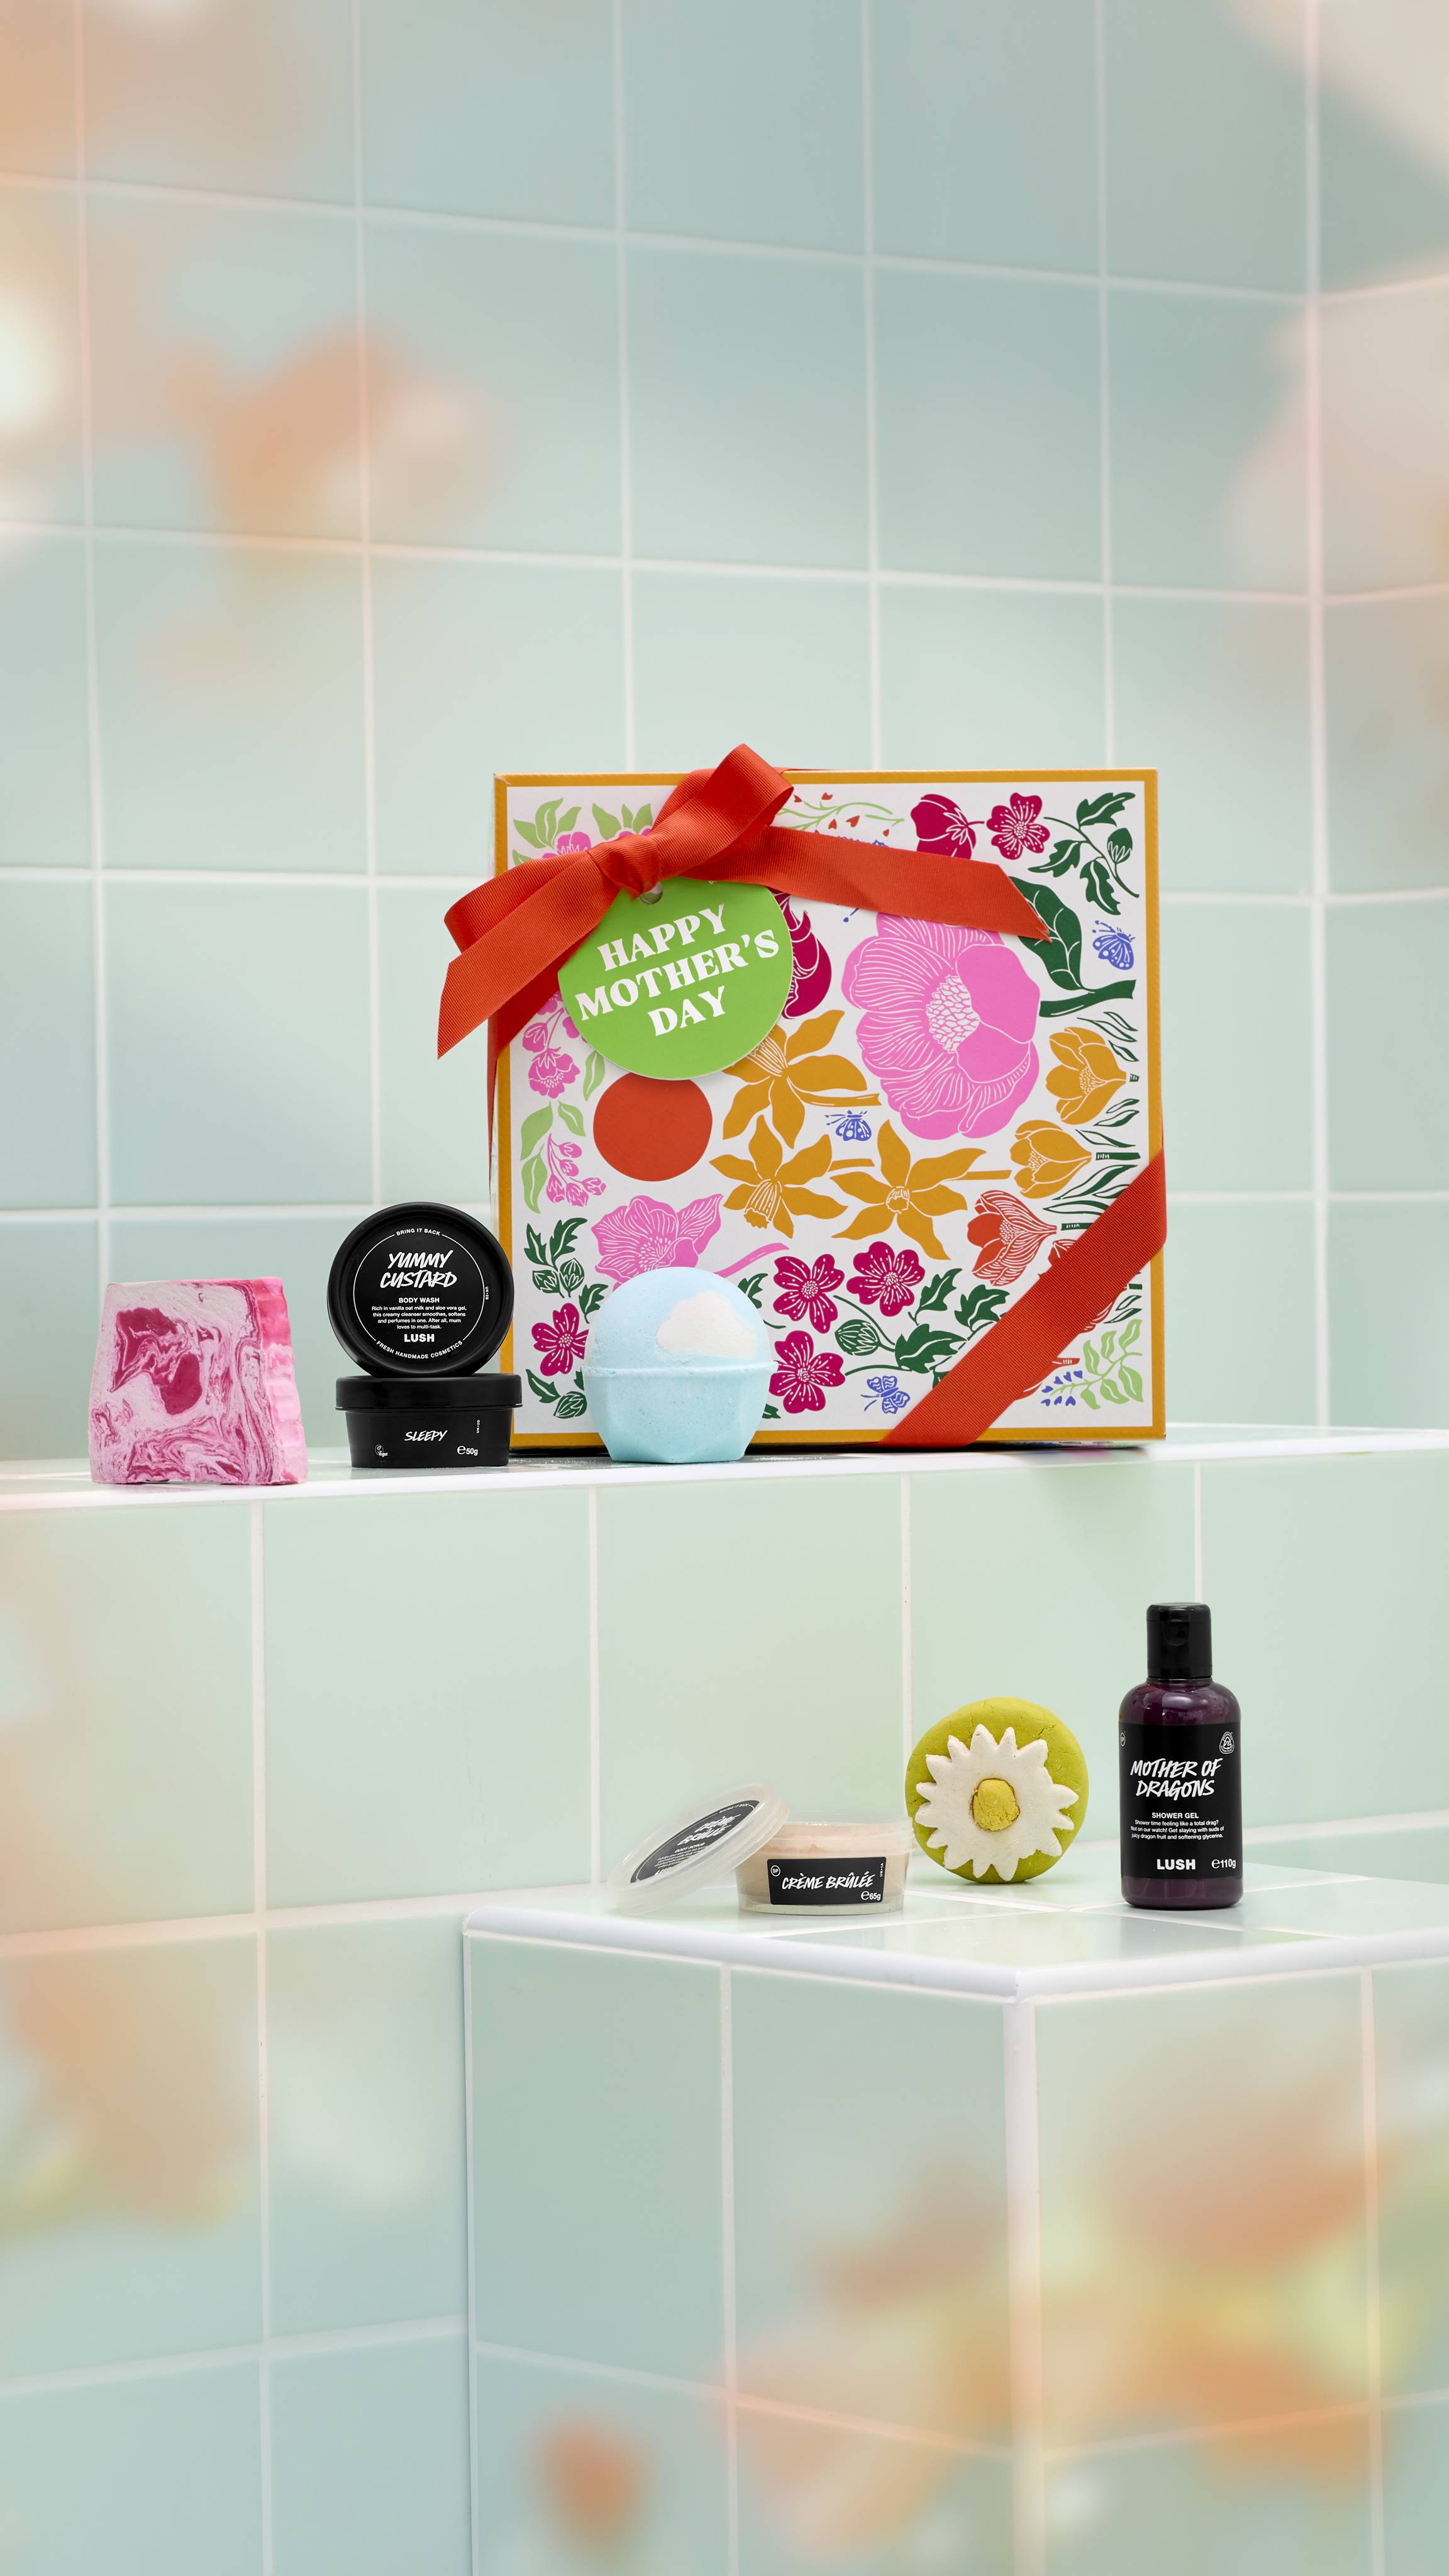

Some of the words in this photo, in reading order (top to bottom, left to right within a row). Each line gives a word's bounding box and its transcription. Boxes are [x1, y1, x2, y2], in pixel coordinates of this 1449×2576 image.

[597, 903, 726, 971] HAPPY
[574, 929, 780, 1021] MOTHER'S
[647, 985, 726, 1036] DAY
[396, 1228, 415, 1236] BRING
[387, 1250, 453, 1269] YUMMY
[380, 1270, 457, 1289] CUSTARD
[404, 1333, 435, 1343] LUSH
[376, 1340, 394, 1354] FRESH
[395, 1351, 429, 1359] HANDMADE
[431, 1340, 463, 1358] COSMETICS
[404, 1430, 448, 1441] SLEEPY
[1130, 1758, 1198, 1779] MOTHER
[1201, 1757, 1223, 1777] OF
[1136, 1779, 1215, 1801] DRAGONS
[1157, 1858, 1196, 1870] LUSH
[782, 1873, 824, 1890] CRÈME
[825, 1871, 875, 1889] BRÛLÉE
